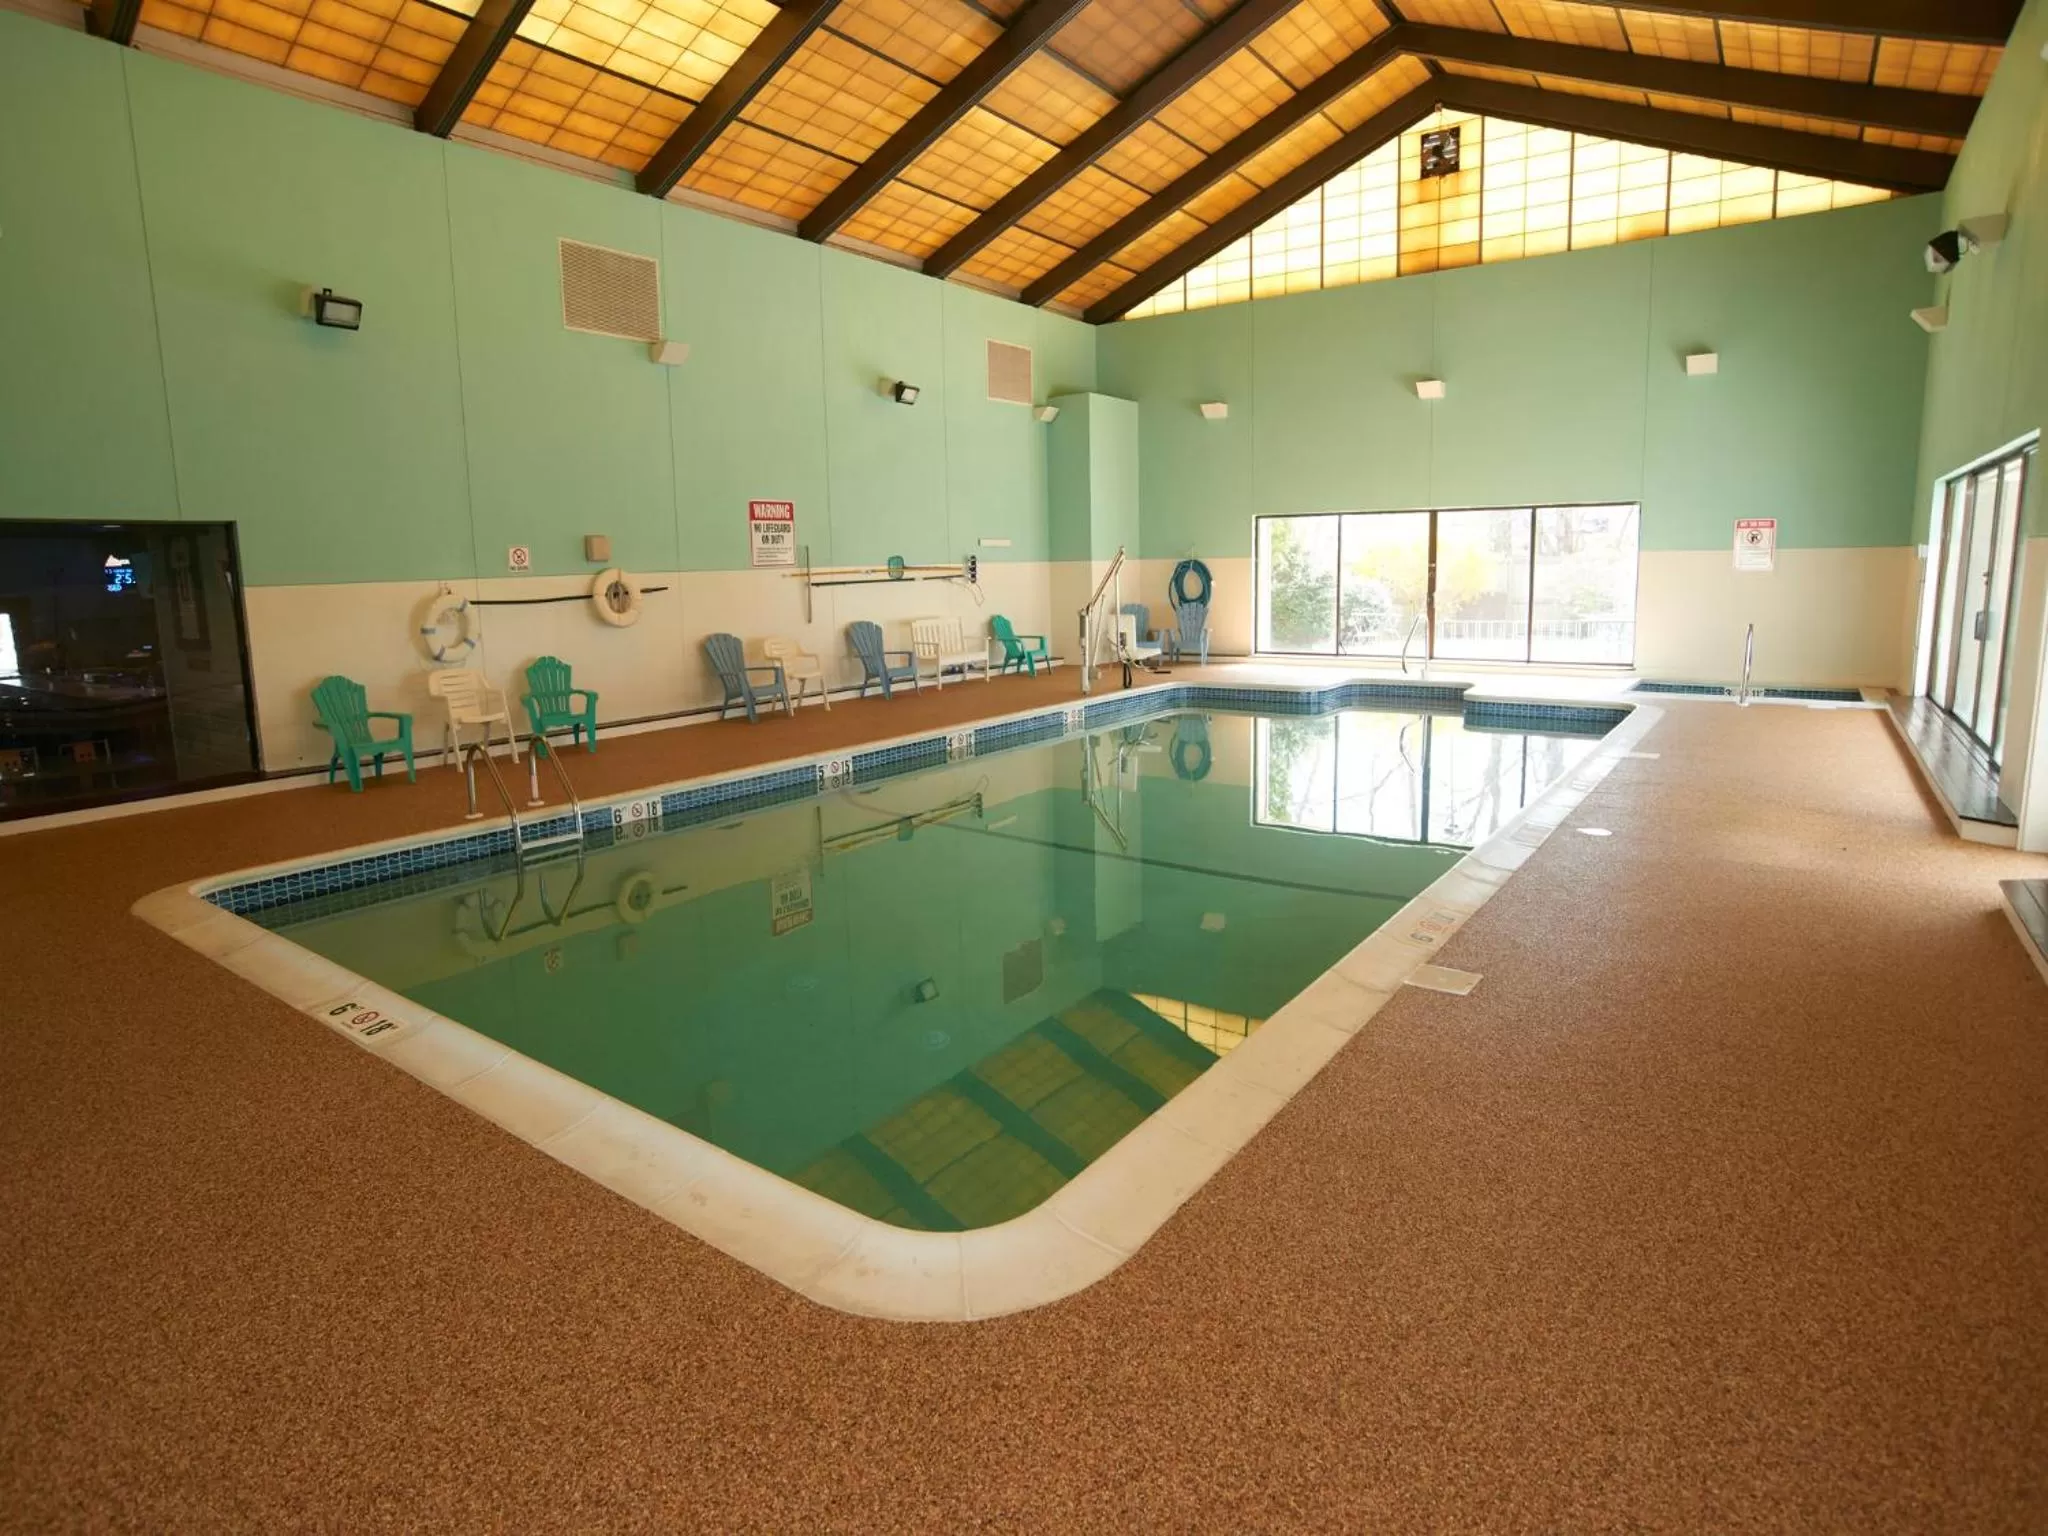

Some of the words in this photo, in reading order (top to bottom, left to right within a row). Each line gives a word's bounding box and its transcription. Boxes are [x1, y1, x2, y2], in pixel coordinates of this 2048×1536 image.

[753, 504, 790, 519] WARNING
[763, 523, 791, 533] LIFEGUARD
[771, 535, 785, 545] DUTY
